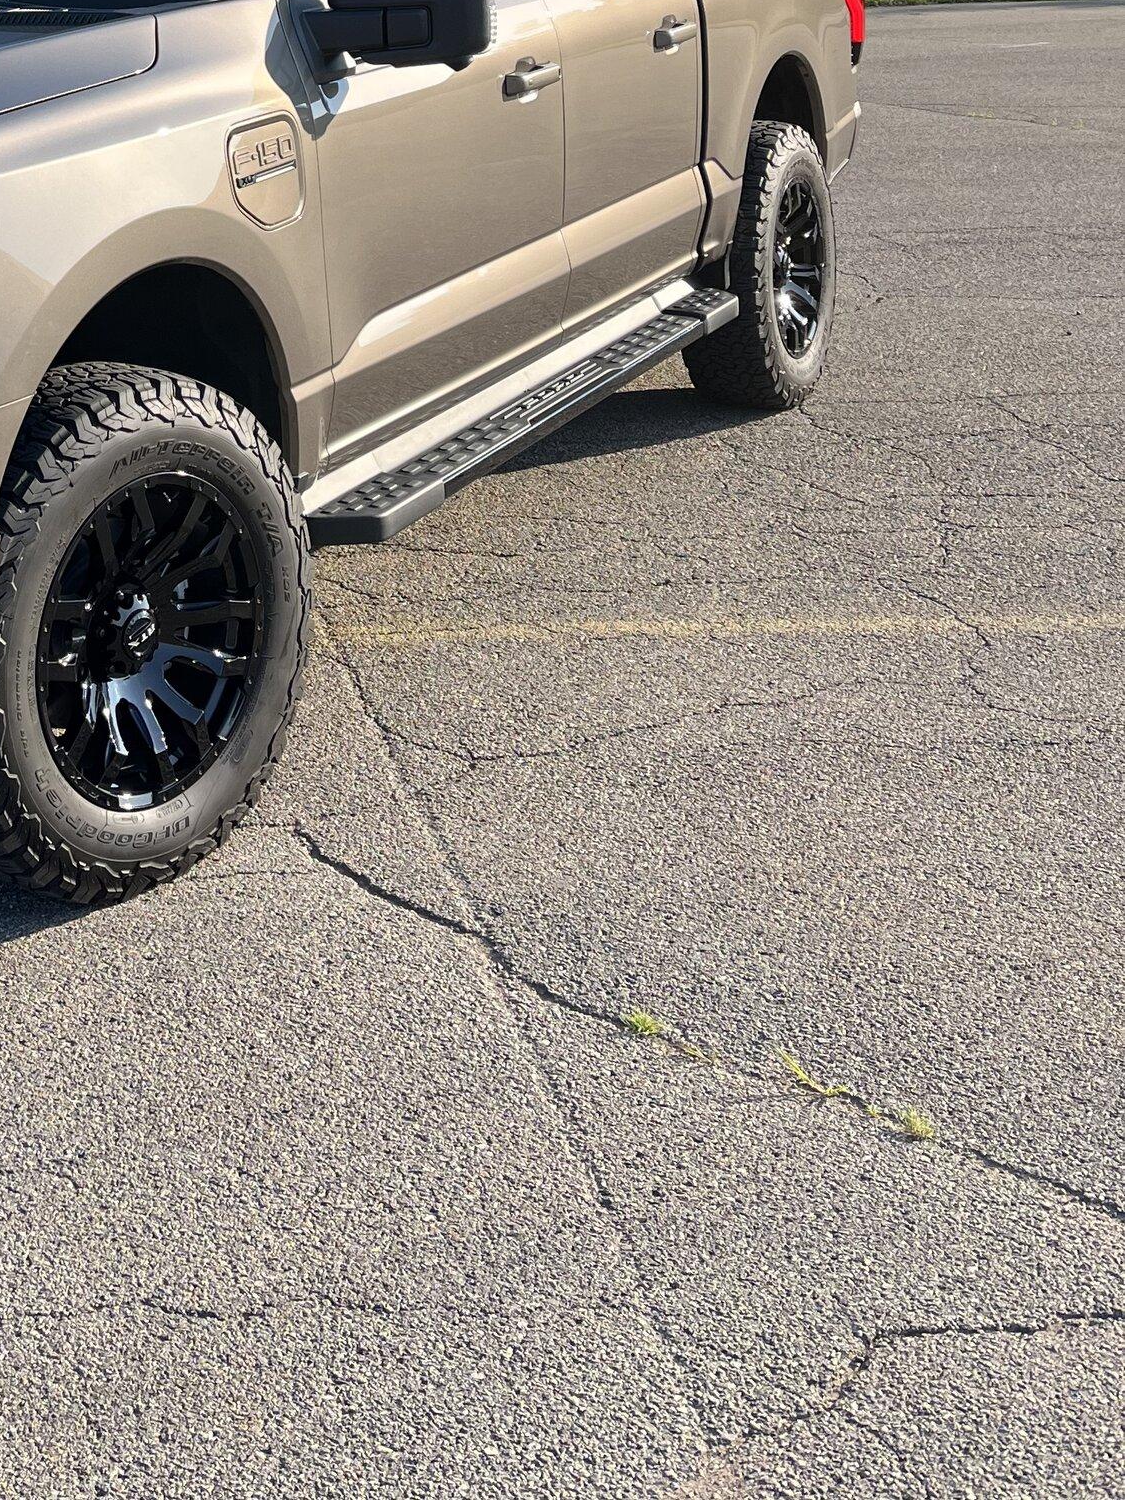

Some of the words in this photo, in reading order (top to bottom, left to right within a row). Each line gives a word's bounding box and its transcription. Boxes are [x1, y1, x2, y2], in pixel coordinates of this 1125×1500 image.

[233, 134, 294, 175] F-150
[256, 502, 284, 557] T/A
[281, 566, 291, 603] KO2
[35, 768, 190, 849] BFGoodrich
